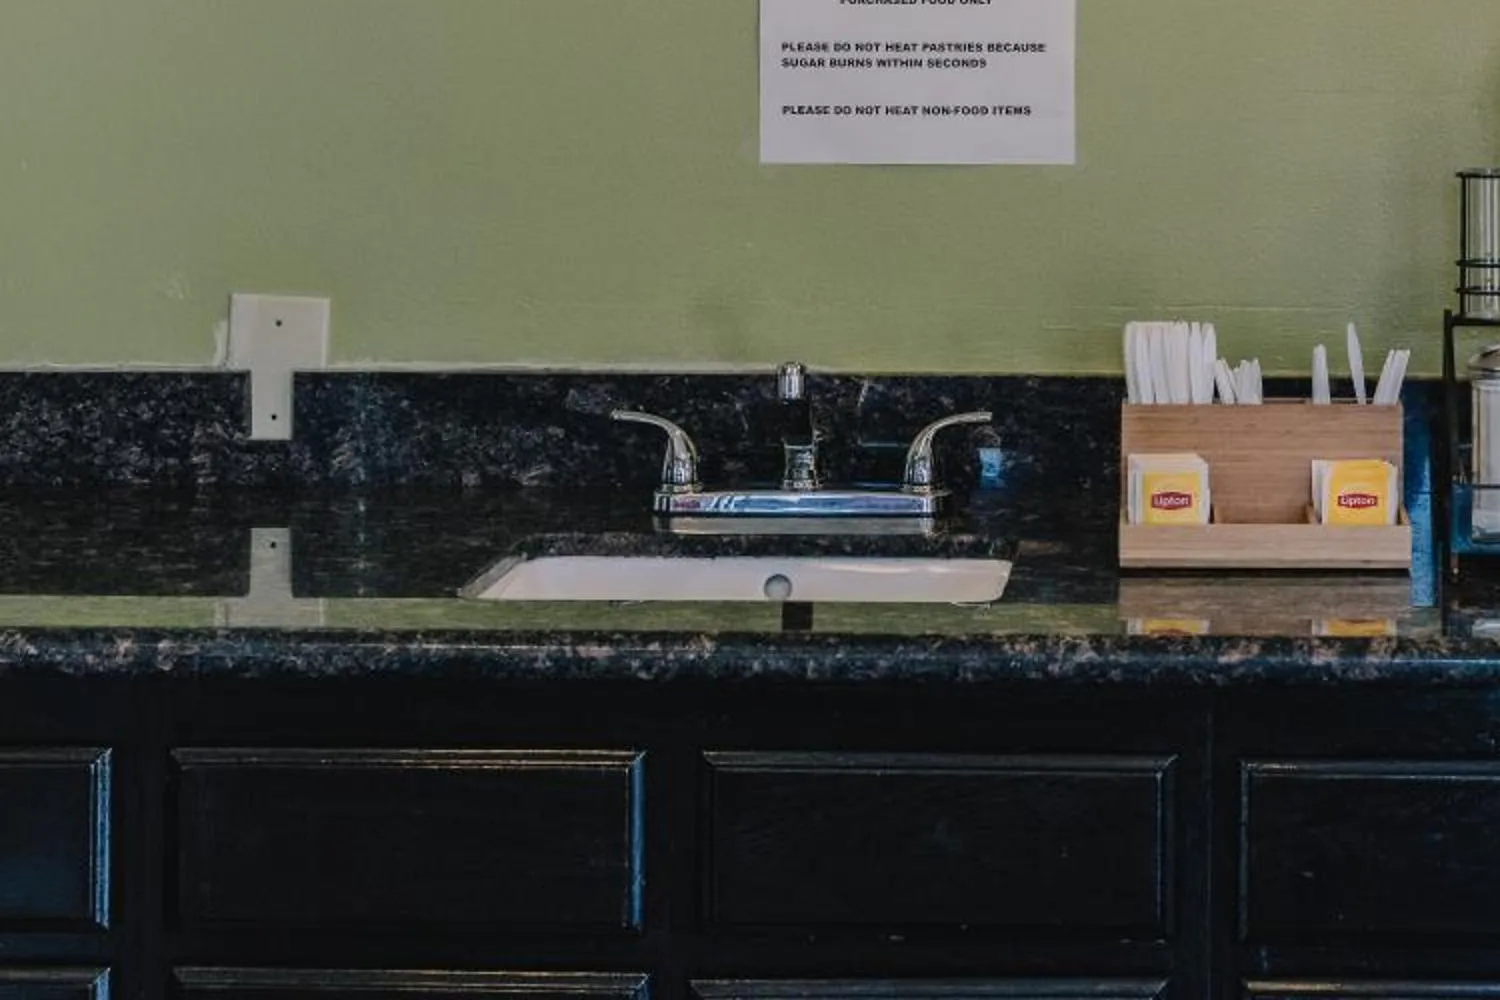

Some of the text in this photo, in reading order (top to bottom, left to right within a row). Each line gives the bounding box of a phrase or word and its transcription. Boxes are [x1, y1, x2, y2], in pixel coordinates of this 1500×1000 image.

[781, 42, 1045, 53] PLEASE DO NOT HEAT PASTRIES BECAUSE
[781, 57, 987, 69] SUGAR BURNS WITHIN SECONDS
[781, 105, 1032, 117] PLEASE DO NOT HEAT NON-FOOD ITEMS
[1153, 494, 1190, 507] Lipton
[1341, 493, 1376, 507] Lipton
